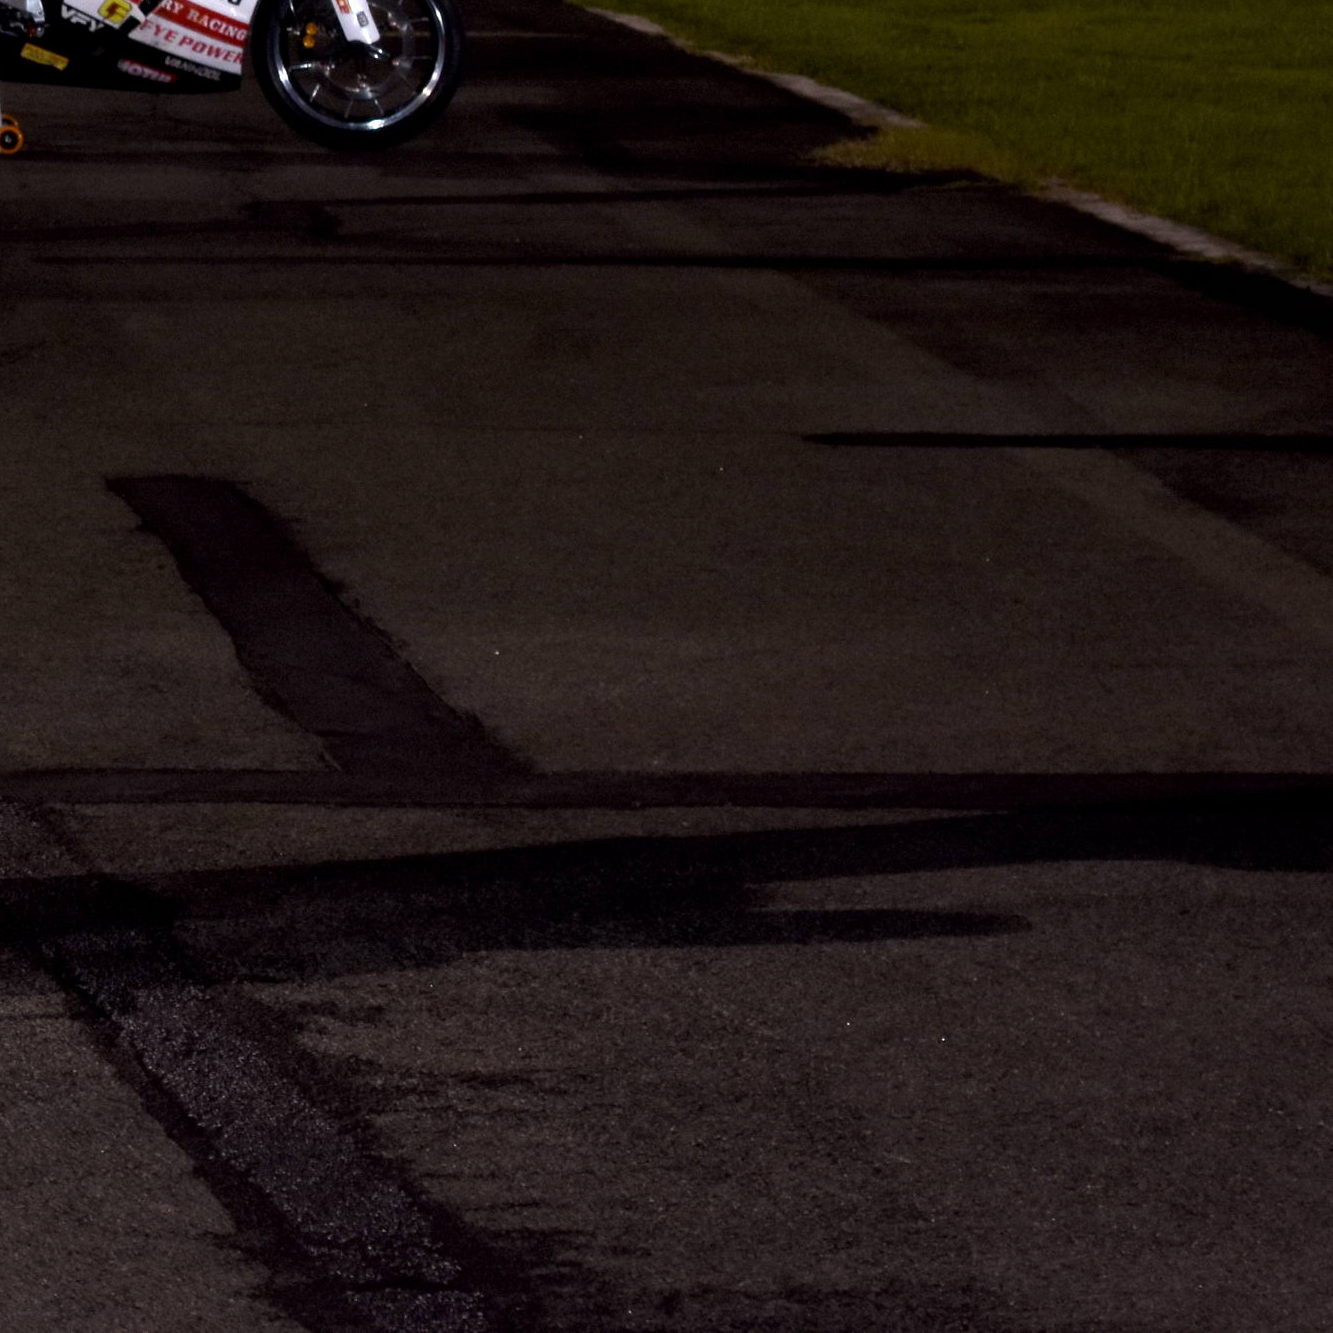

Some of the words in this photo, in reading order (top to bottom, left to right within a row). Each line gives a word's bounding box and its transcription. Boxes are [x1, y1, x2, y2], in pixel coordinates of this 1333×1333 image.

[139, 19, 178, 42] FYE
[180, 36, 245, 64] POWER
[188, 9, 248, 41] RACING
